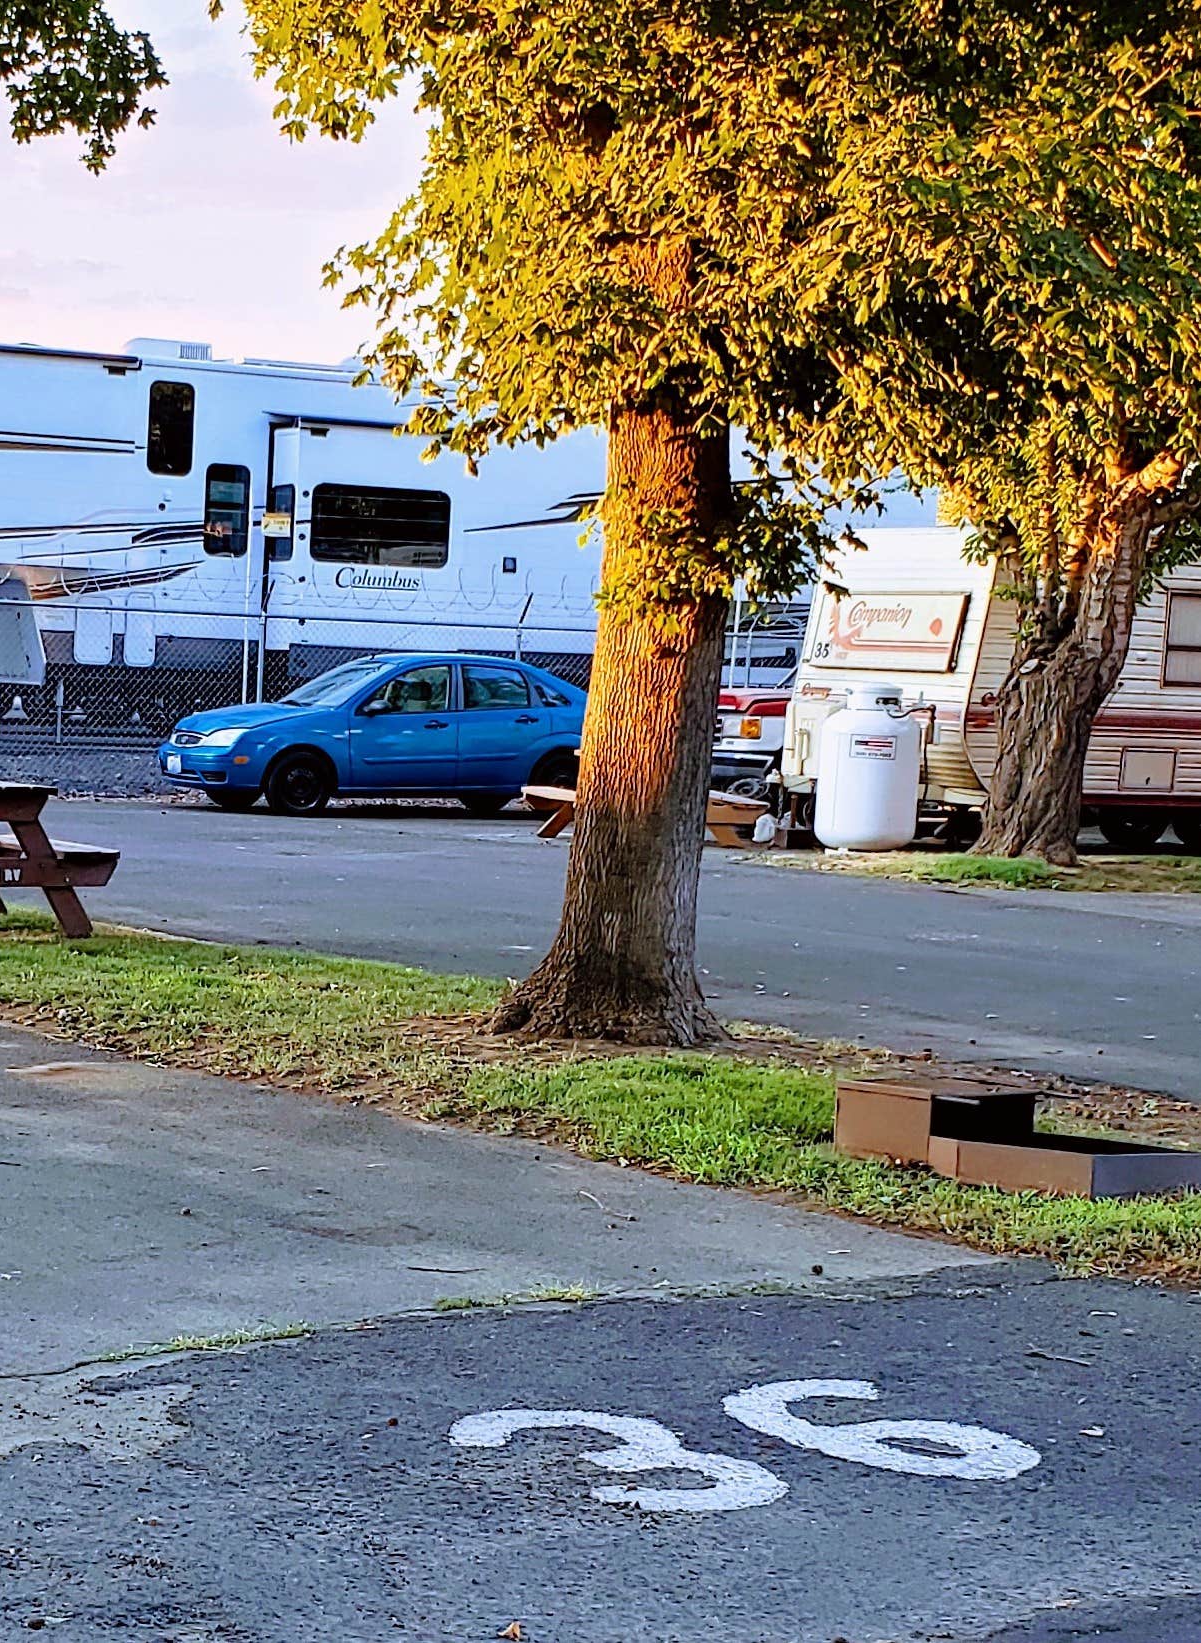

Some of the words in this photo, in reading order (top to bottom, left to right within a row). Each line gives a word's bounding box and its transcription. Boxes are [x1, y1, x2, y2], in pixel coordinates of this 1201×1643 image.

[335, 566, 421, 590] Columbus
[847, 600, 913, 629] Companion
[814, 642, 830, 659] 35
[4, 869, 21, 881] RV
